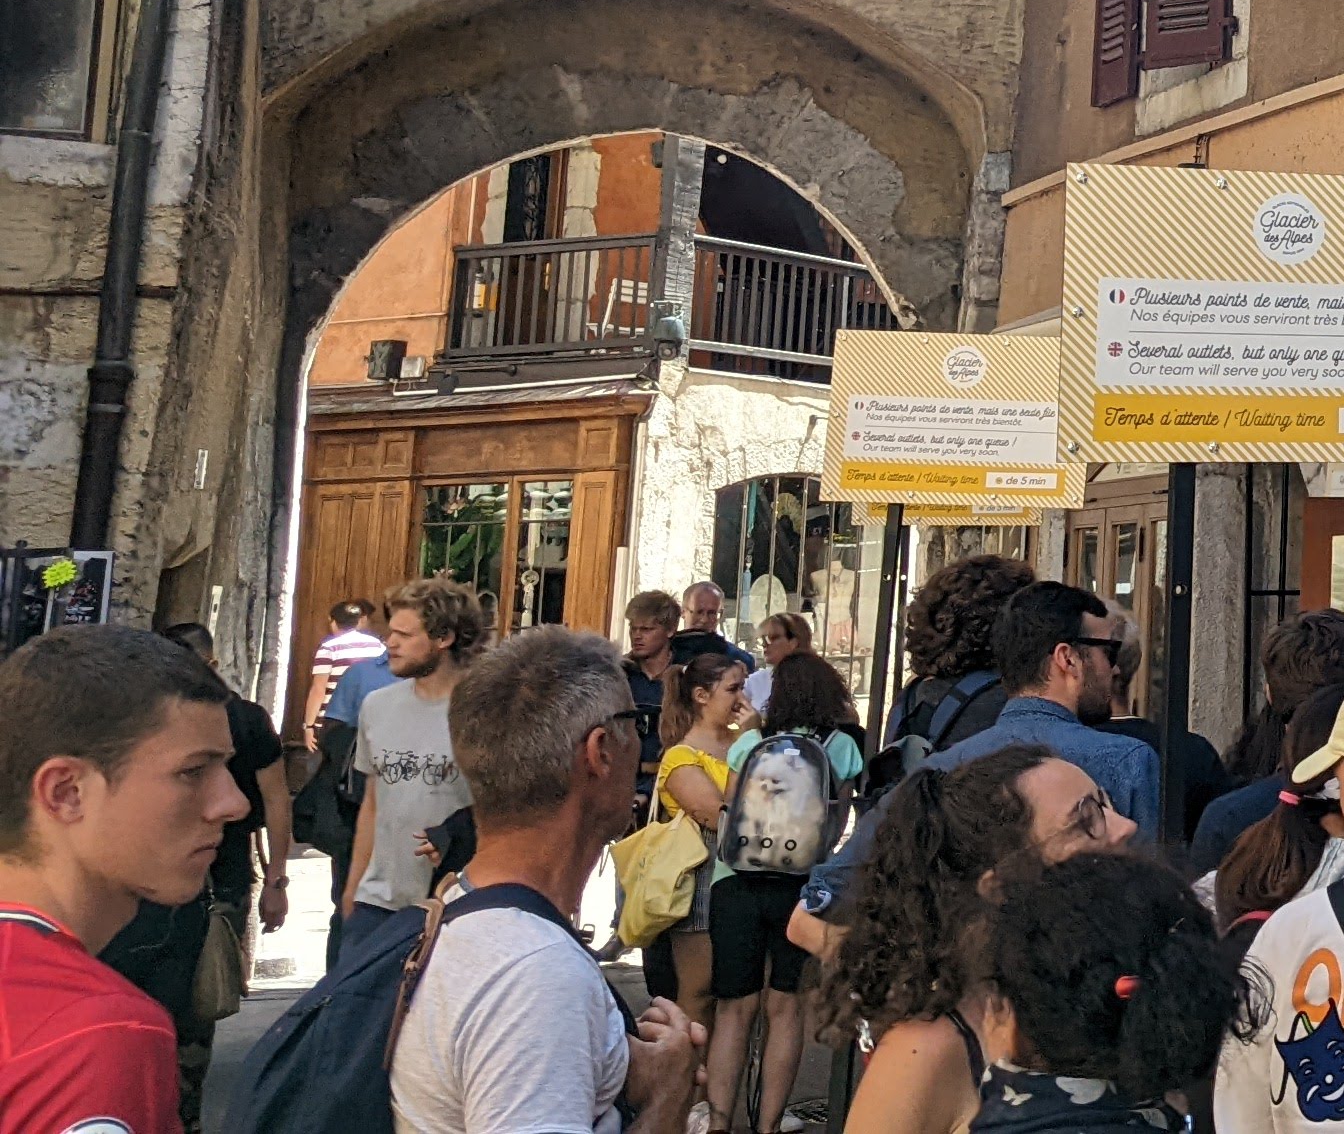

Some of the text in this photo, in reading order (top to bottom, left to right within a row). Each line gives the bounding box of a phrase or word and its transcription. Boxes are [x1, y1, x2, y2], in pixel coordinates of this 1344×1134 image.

[1260, 210, 1319, 233] Glacier
[1264, 229, 1313, 250] des Alpes
[1129, 287, 1201, 306] Plusieurs
[1204, 293, 1248, 311] points
[1253, 293, 1271, 308] de
[1130, 309, 1158, 322] Nos
[1162, 310, 1216, 325] équipes
[1219, 313, 1250, 324] vous
[1253, 313, 1310, 326] serviront
[1313, 314, 1338, 326] très
[1128, 340, 1183, 359] Several
[1187, 344, 1235, 361] outlets,
[1242, 345, 1265, 360] but
[1268, 346, 1300, 366] only
[1304, 349, 1328, 362] one
[947, 356, 983, 369] Glacier
[1129, 362, 1156, 376] Our
[1159, 364, 1194, 376] team
[1198, 364, 1220, 376] will
[1223, 366, 1258, 377] serve
[1261, 367, 1287, 380] you
[1291, 367, 1318, 381] very
[866, 400, 908, 412] Plusieurs
[910, 404, 936, 415] points
[939, 405, 950, 413] de
[978, 407, 999, 416] mais
[1002, 408, 1017, 416] une
[1019, 408, 1040, 417] seule
[866, 413, 882, 421] Nos
[885, 413, 916, 423] équipes
[939, 416, 973, 424] serviront
[1104, 407, 1154, 429] Temps
[1160, 409, 1219, 427] d'attente
[1235, 409, 1292, 432] Waiting
[1296, 412, 1326, 427] time
[863, 431, 895, 442] Several
[930, 435, 944, 444] but
[947, 436, 965, 448] only
[985, 439, 1009, 448] queue
[863, 443, 878, 451] Our
[941, 448, 957, 456] you
[960, 448, 976, 457] very
[847, 469, 876, 483] Temps
[923, 472, 958, 486] Waiting
[960, 475, 979, 484] time
[1006, 476, 1046, 485] de 5 min
